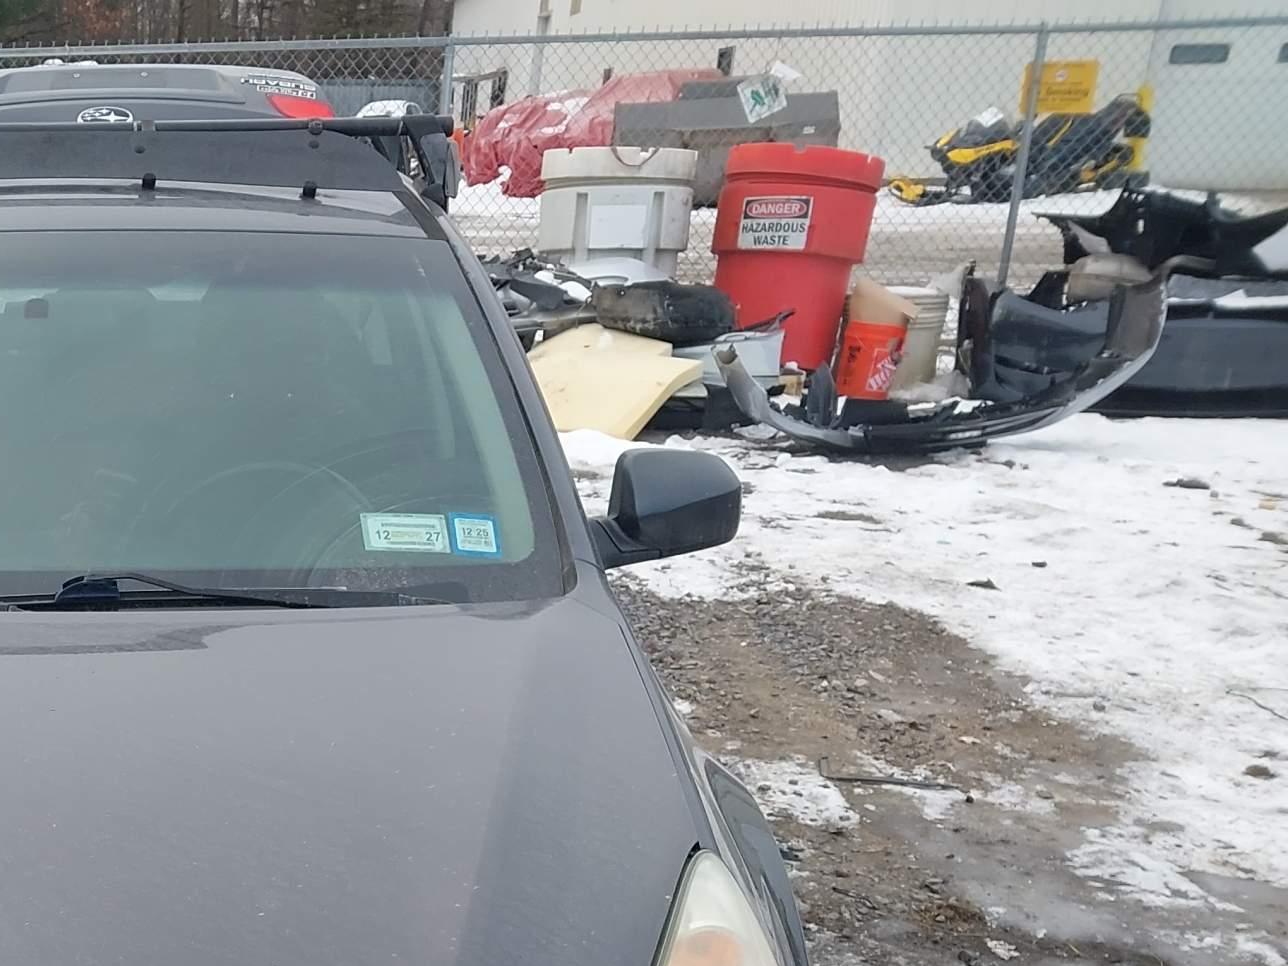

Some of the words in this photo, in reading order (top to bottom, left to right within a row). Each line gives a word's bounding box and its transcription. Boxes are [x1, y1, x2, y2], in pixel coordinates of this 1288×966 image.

[752, 203, 801, 215] DANGER
[741, 222, 806, 233] HAZARDOUS
[753, 235, 790, 246] WASTE
[375, 530, 392, 541] 12
[425, 531, 441, 542] 27
[462, 527, 473, 536] 12
